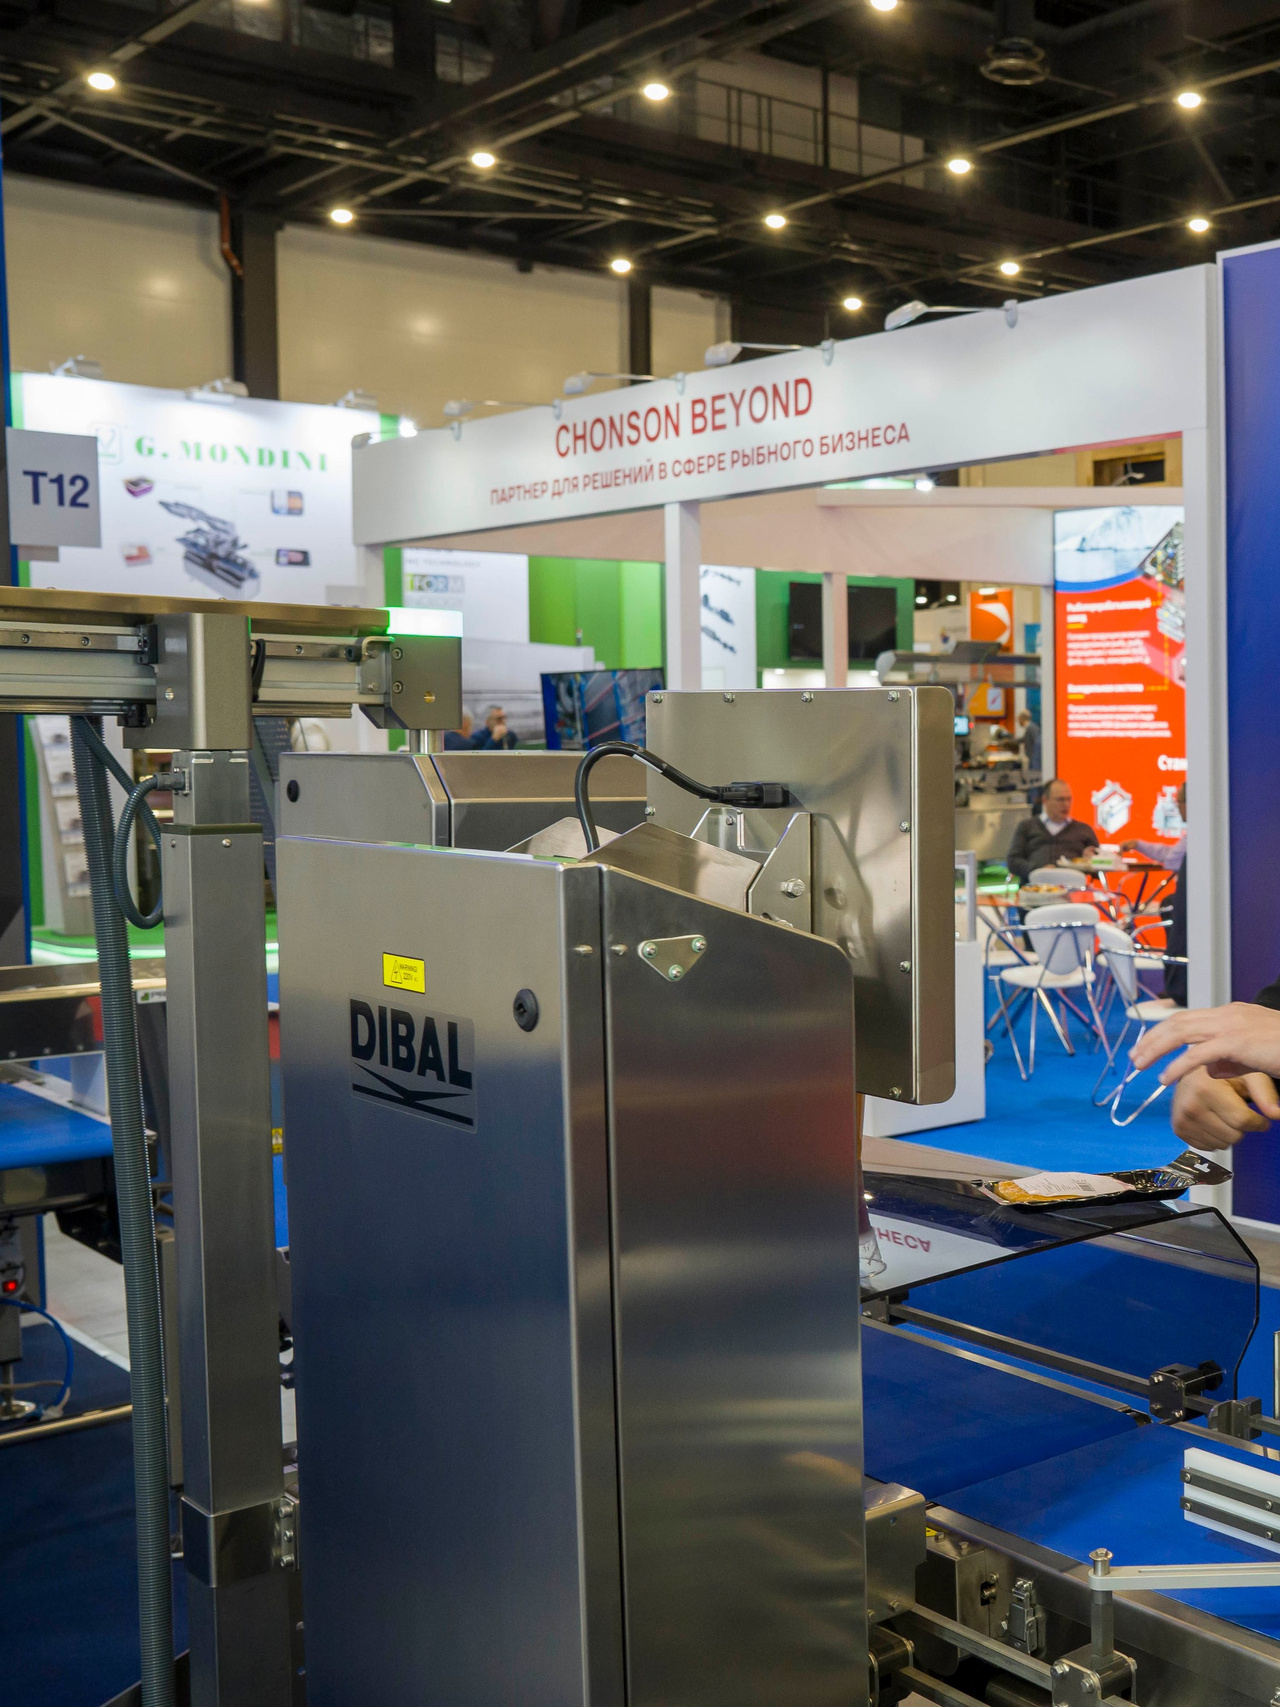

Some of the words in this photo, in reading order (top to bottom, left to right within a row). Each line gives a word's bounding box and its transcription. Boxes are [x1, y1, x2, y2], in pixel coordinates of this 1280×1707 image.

[135, 436, 169, 458] G.
[181, 441, 328, 472] MONDINI
[555, 405, 681, 458] CHONSON
[691, 377, 813, 436] BEYOND
[22, 470, 90, 508] T12
[490, 481, 549, 506] ПАРТНЕР
[551, 476, 580, 500] ДЛЯ
[582, 459, 655, 491] РЕШЕНИЙ
[658, 461, 668, 480] В
[671, 451, 727, 478] СФЕРЕ
[730, 438, 815, 470] РЫБНОГО
[819, 422, 911, 456] БИЗНЕСА
[350, 999, 473, 1090] DIBAL
